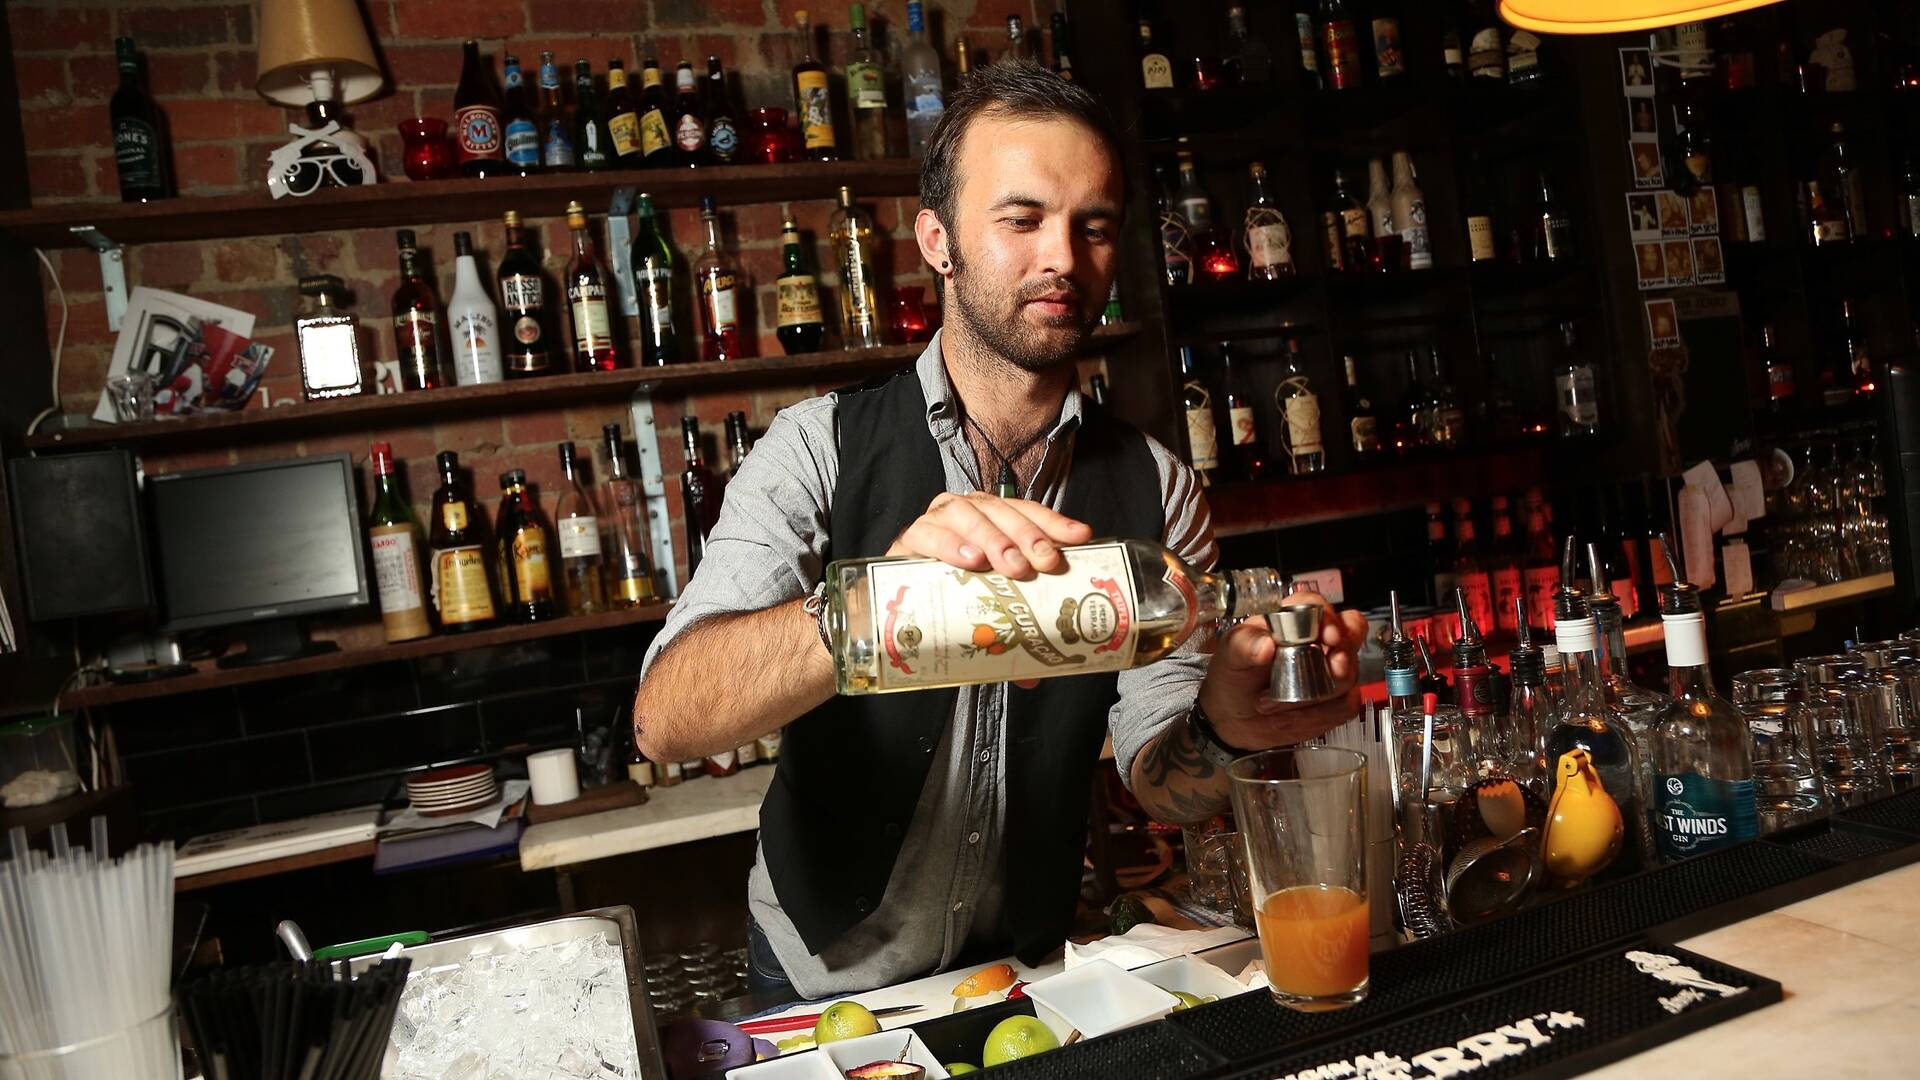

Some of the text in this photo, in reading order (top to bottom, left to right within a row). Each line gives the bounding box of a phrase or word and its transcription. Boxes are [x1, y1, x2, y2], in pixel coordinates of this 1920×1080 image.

[470, 124, 487, 138] M
[1670, 808, 1685, 816] THE
[1676, 817, 1728, 835] WINDS
[1672, 834, 1689, 843] GIN
